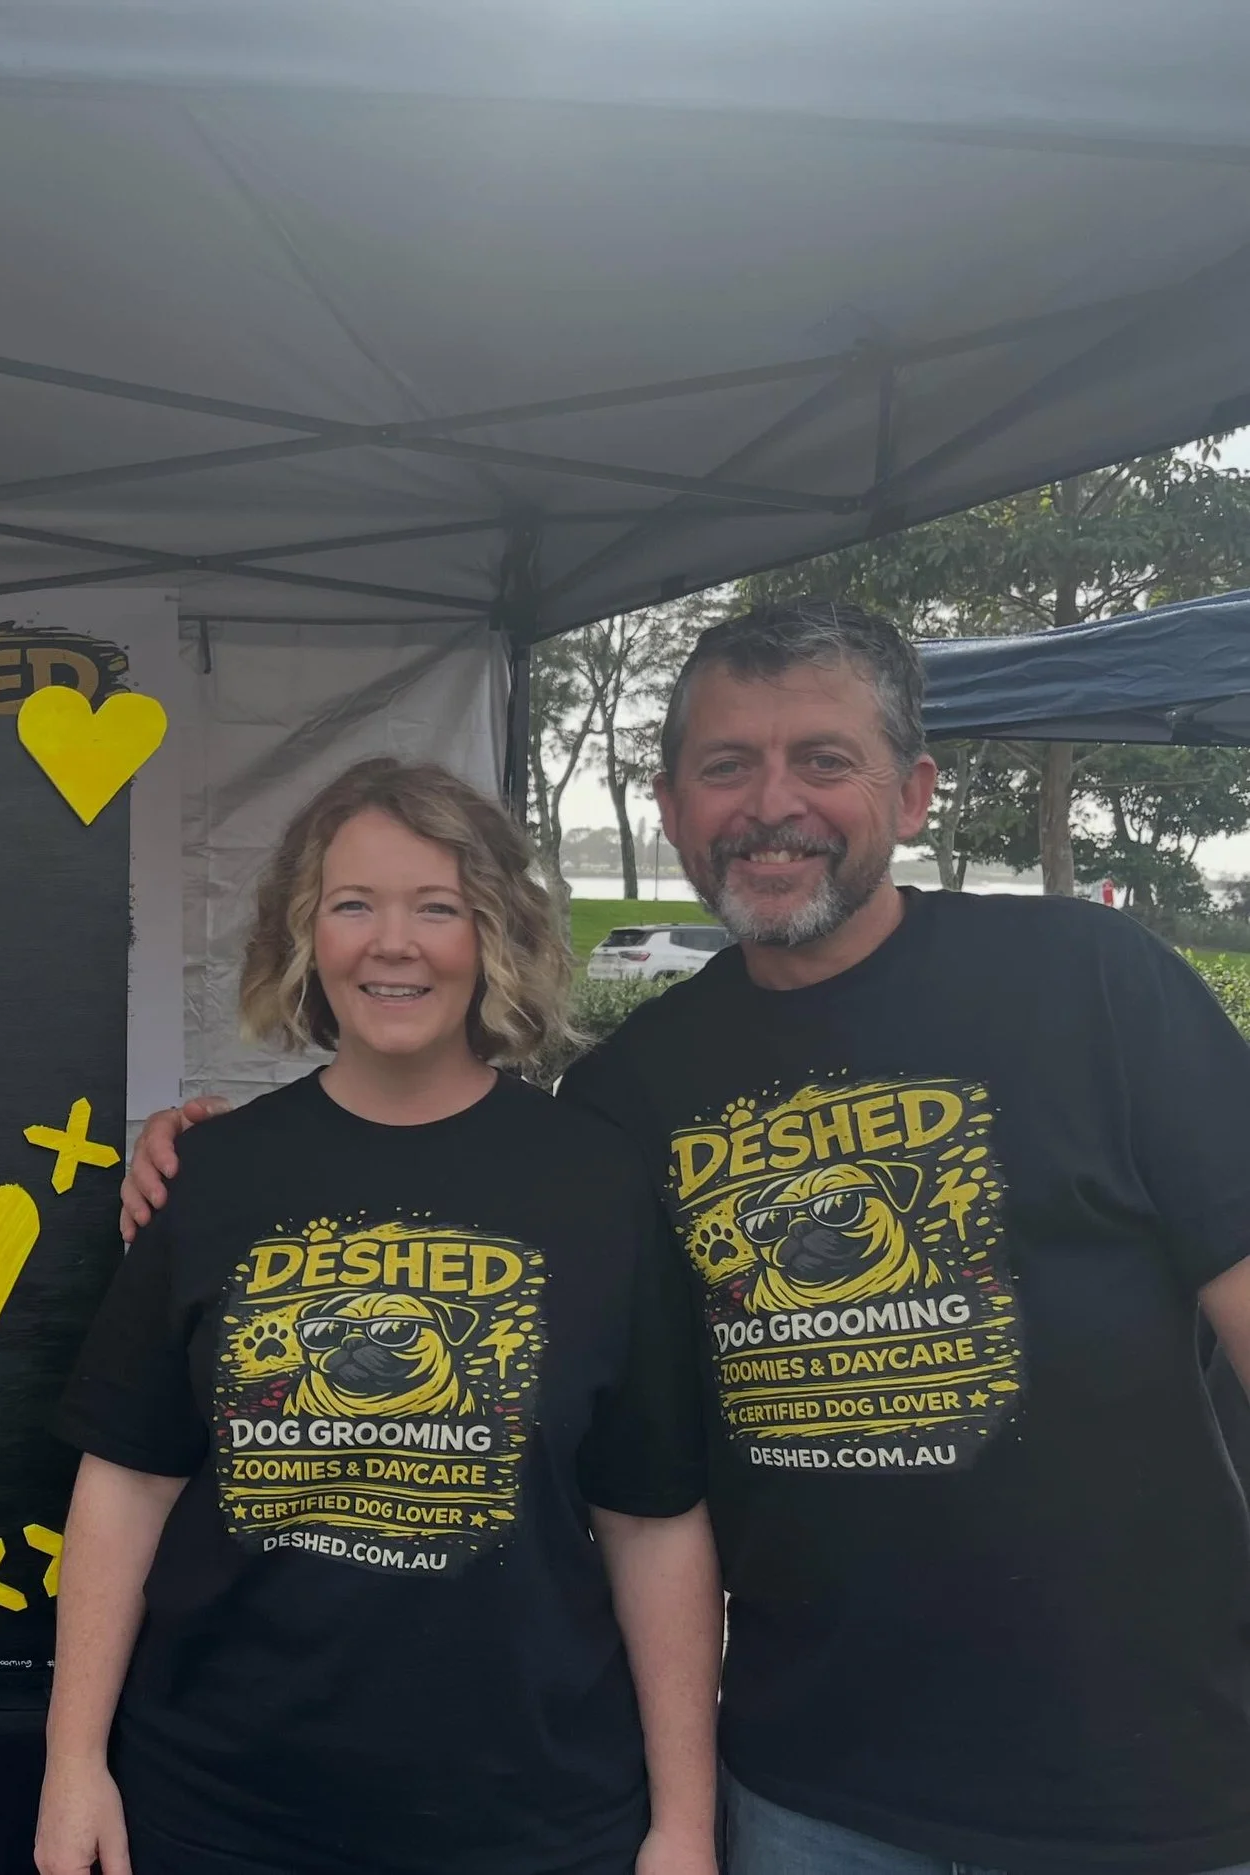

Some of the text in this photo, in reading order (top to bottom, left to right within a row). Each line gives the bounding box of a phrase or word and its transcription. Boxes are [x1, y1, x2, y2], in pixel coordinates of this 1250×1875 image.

[671, 1089, 963, 1200] DESHED
[246, 1242, 522, 1296] DESHED
[714, 1294, 970, 1352] DOG GROOMING
[720, 1338, 976, 1384] ZOOMIES & DAYCARE
[739, 1391, 961, 1423] CERTIFIED DOG LOVER
[229, 1418, 491, 1451] DOG GROOMING
[231, 1458, 487, 1486] ZOOMIES & DAYCARE
[751, 1445, 956, 1469] DESHED.COM.AU
[251, 1495, 463, 1524] CERTIFIED DOG LOVER
[263, 1532, 447, 1570] DESHED.COM.AU
